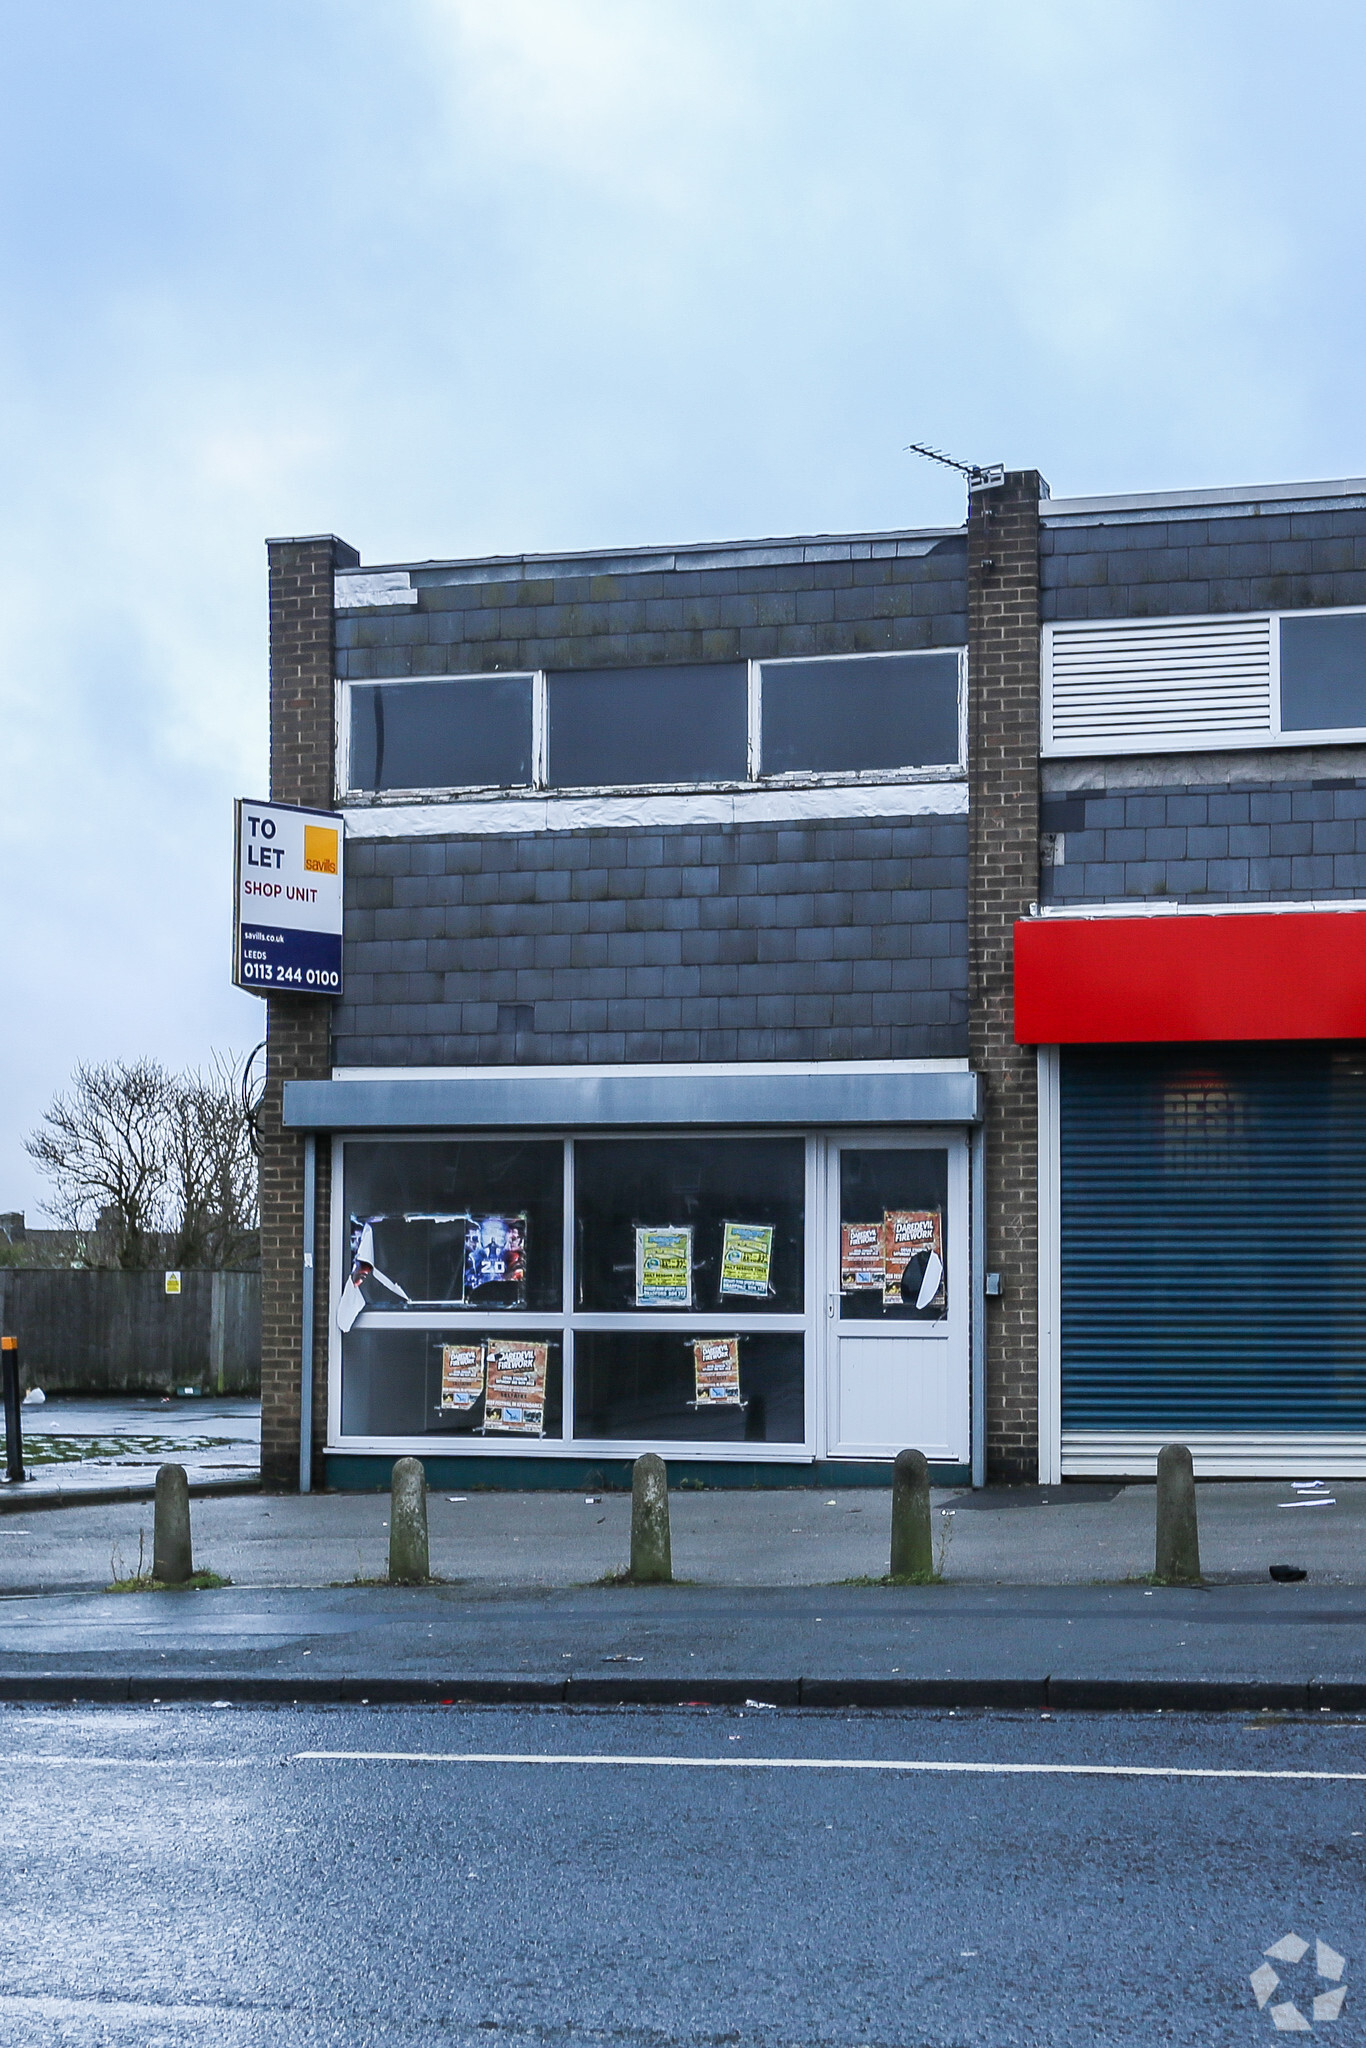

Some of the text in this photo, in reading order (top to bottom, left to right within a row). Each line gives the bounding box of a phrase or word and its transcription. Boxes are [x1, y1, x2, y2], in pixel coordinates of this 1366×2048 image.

[248, 816, 276, 839] TO
[248, 845, 285, 869] LET
[305, 859, 336, 874] savills
[245, 880, 317, 903] SHOP UNIT
[244, 932, 284, 943] savills.co.uk
[244, 950, 267, 960] LEEDS
[244, 963, 339, 986] 0113 244 0100
[895, 1220, 934, 1234] DAREDEVIL
[895, 1230, 933, 1243] FIREWORK
[498, 1350, 535, 1361] DAREDEVIL
[497, 1359, 534, 1371] FIREWORK
